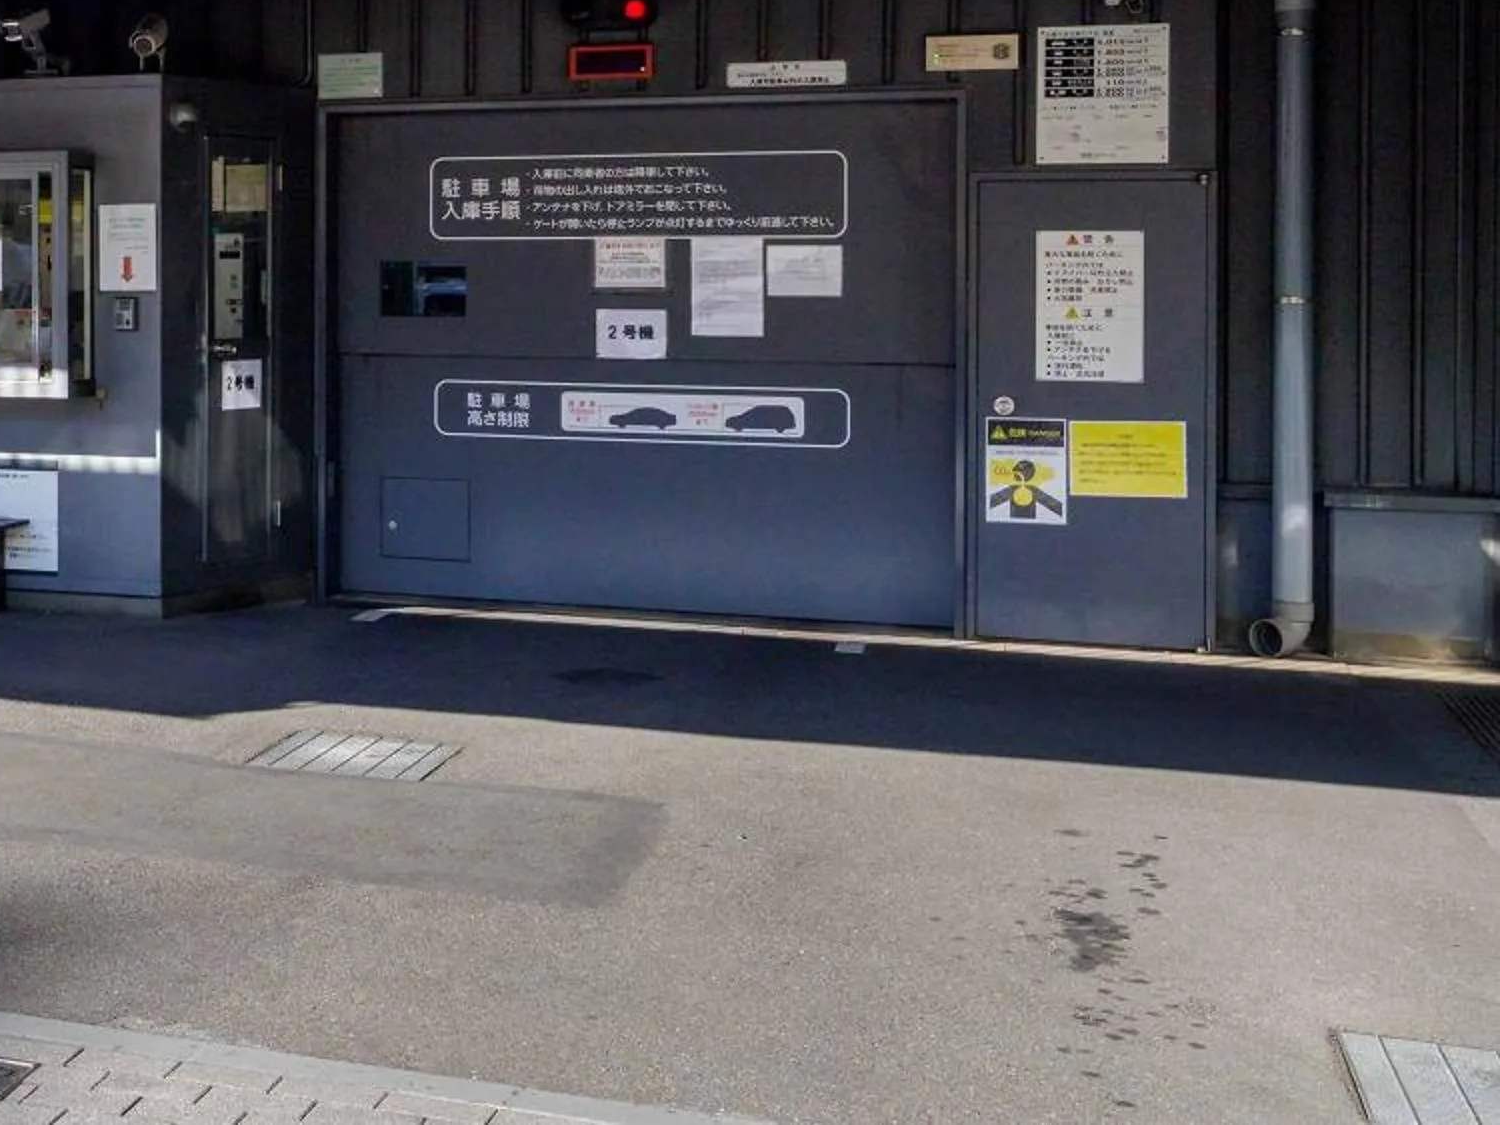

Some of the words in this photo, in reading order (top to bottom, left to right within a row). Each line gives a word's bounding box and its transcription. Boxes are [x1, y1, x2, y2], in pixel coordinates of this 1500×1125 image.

[441, 177, 520, 197] 駐車場
[441, 200, 520, 220] 入庫手順
[607, 324, 654, 340] 2号機
[467, 392, 530, 409] 駐車場
[467, 410, 530, 427] 高さ制限
